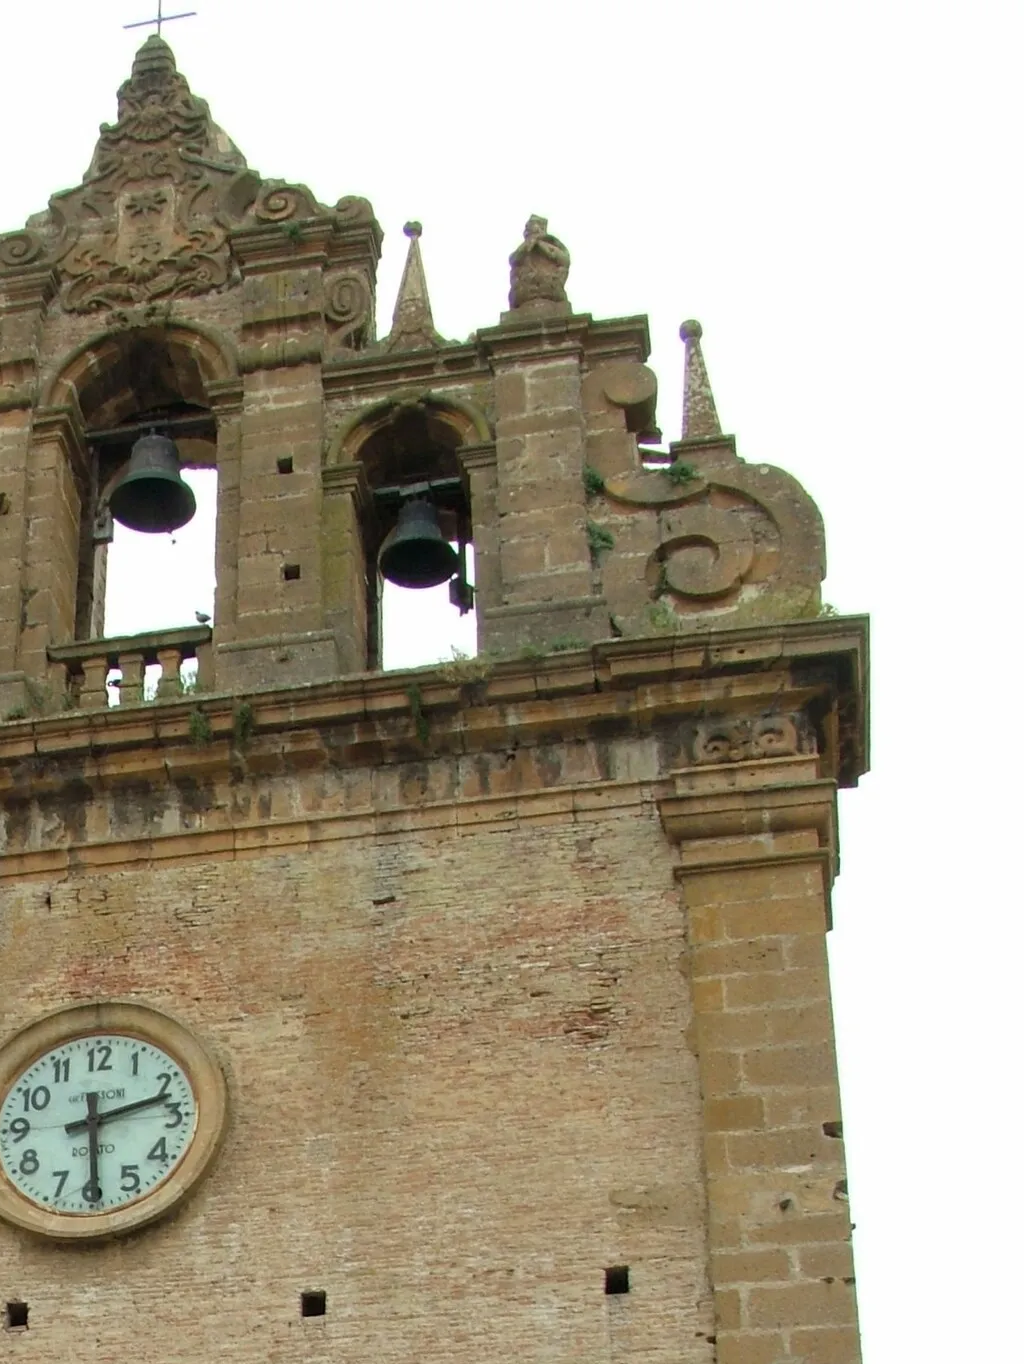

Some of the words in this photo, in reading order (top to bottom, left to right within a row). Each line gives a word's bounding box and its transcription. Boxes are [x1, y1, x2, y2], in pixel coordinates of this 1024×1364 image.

[52, 1057, 71, 1083] 11
[87, 1045, 113, 1072] 12
[131, 1051, 139, 1076] 1
[156, 1073, 172, 1098] 2
[22, 1086, 51, 1112] 10
[164, 1102, 182, 1128] 3
[10, 1117, 30, 1144] 9
[19, 1149, 40, 1175] 8
[147, 1137, 169, 1162] 4
[52, 1171, 70, 1198] 7
[120, 1165, 141, 1192] 5
